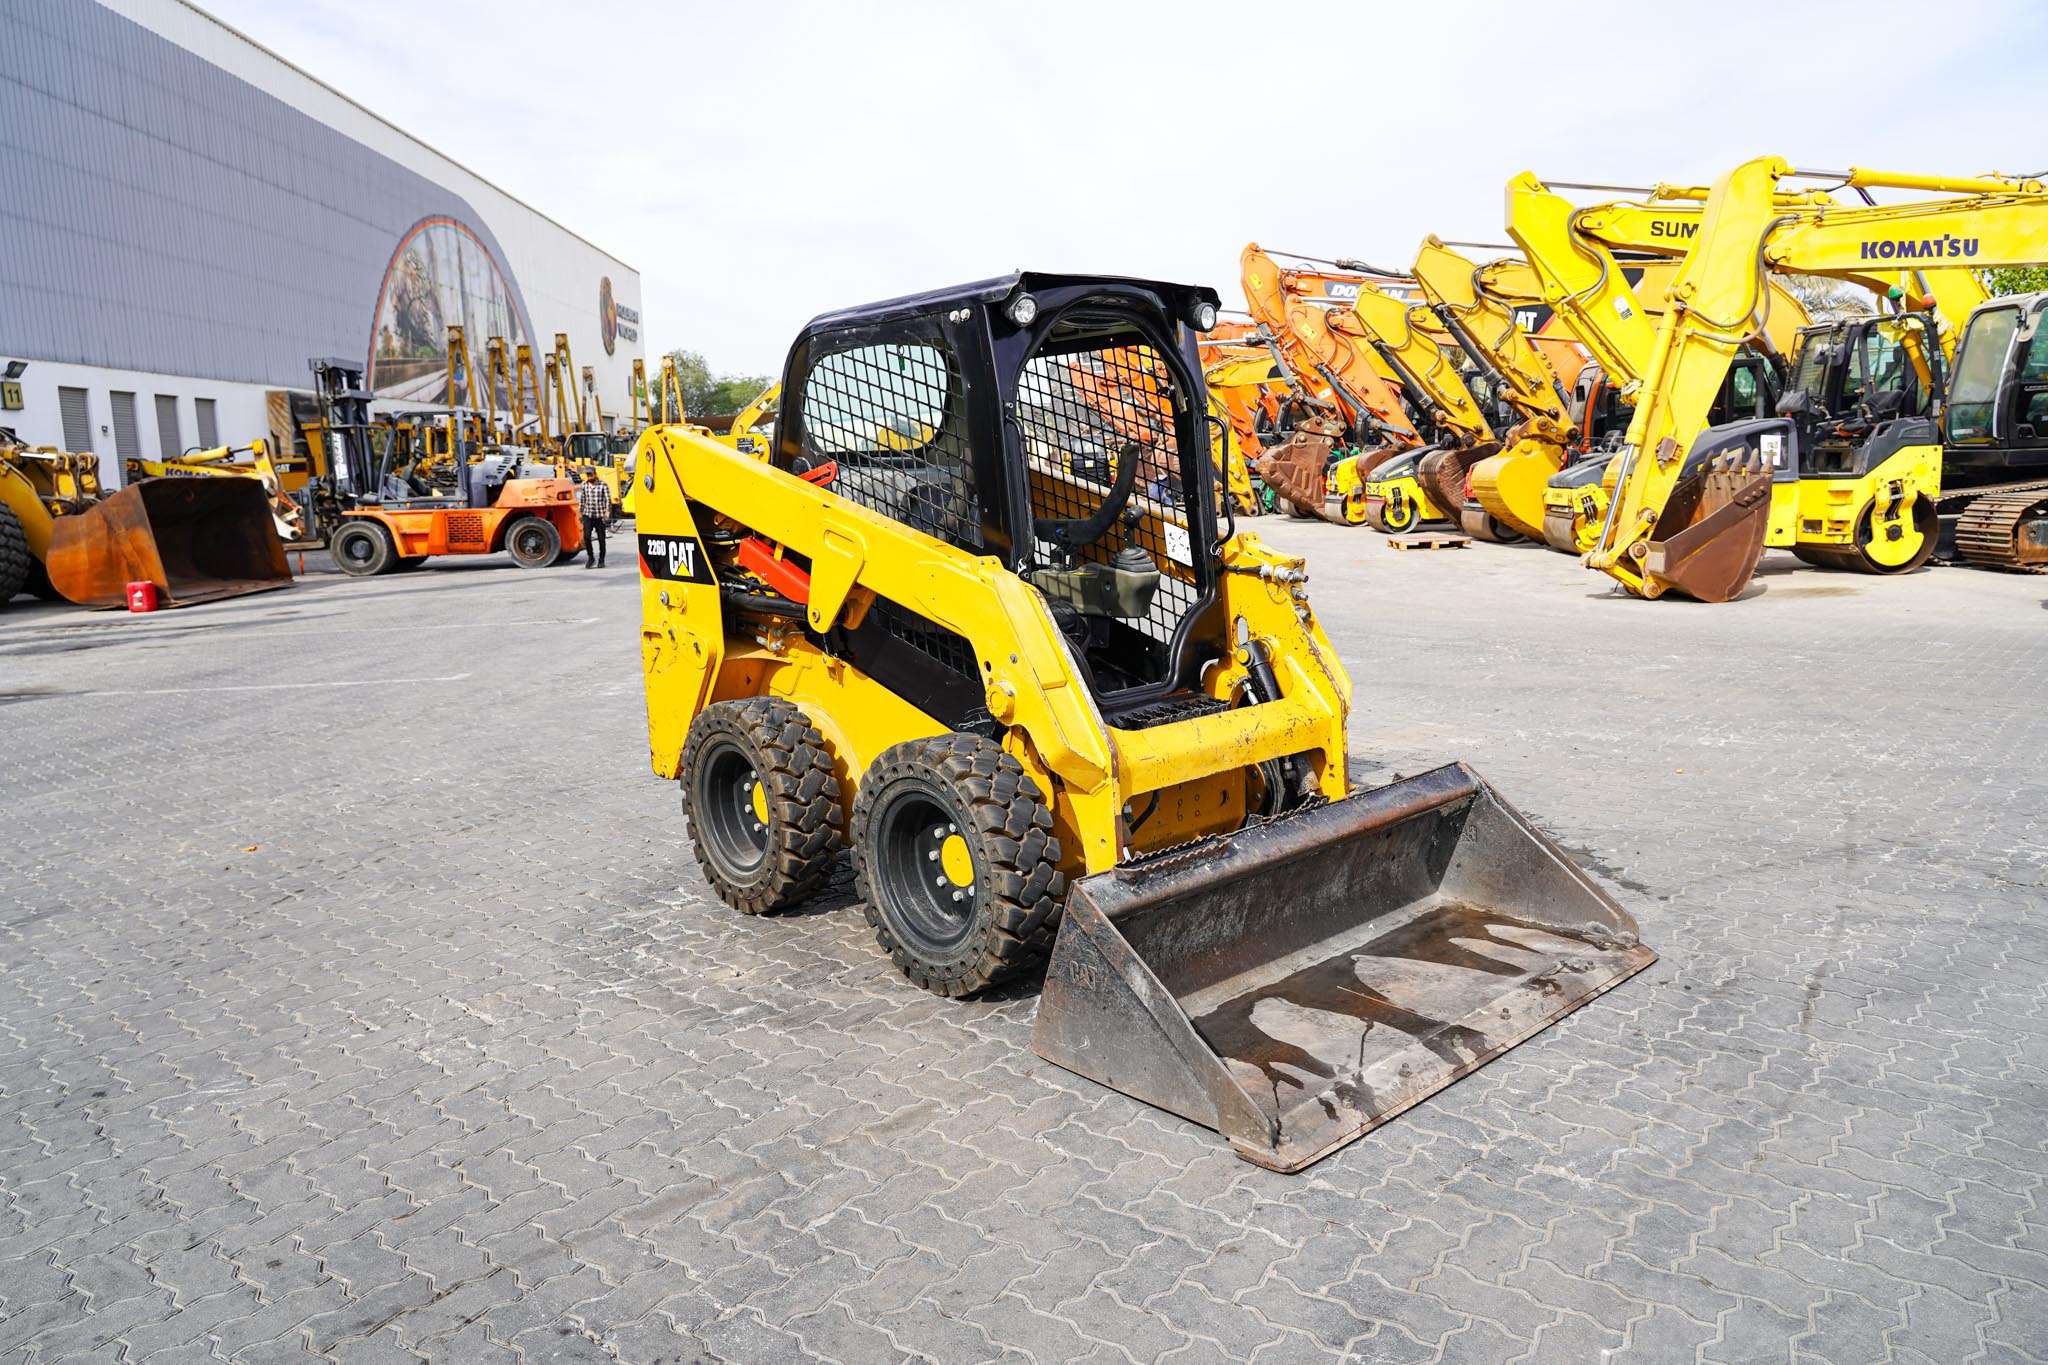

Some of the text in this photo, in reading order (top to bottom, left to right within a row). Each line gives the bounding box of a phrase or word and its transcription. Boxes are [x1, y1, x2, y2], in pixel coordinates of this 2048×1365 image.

[1650, 221, 1699, 239] SUM
[1861, 234, 1978, 259] KOMATSU
[1515, 310, 1538, 333] AT
[8, 388, 20, 403] 11
[647, 540, 695, 577] 226D CAT
[1070, 960, 1098, 991] CAT
